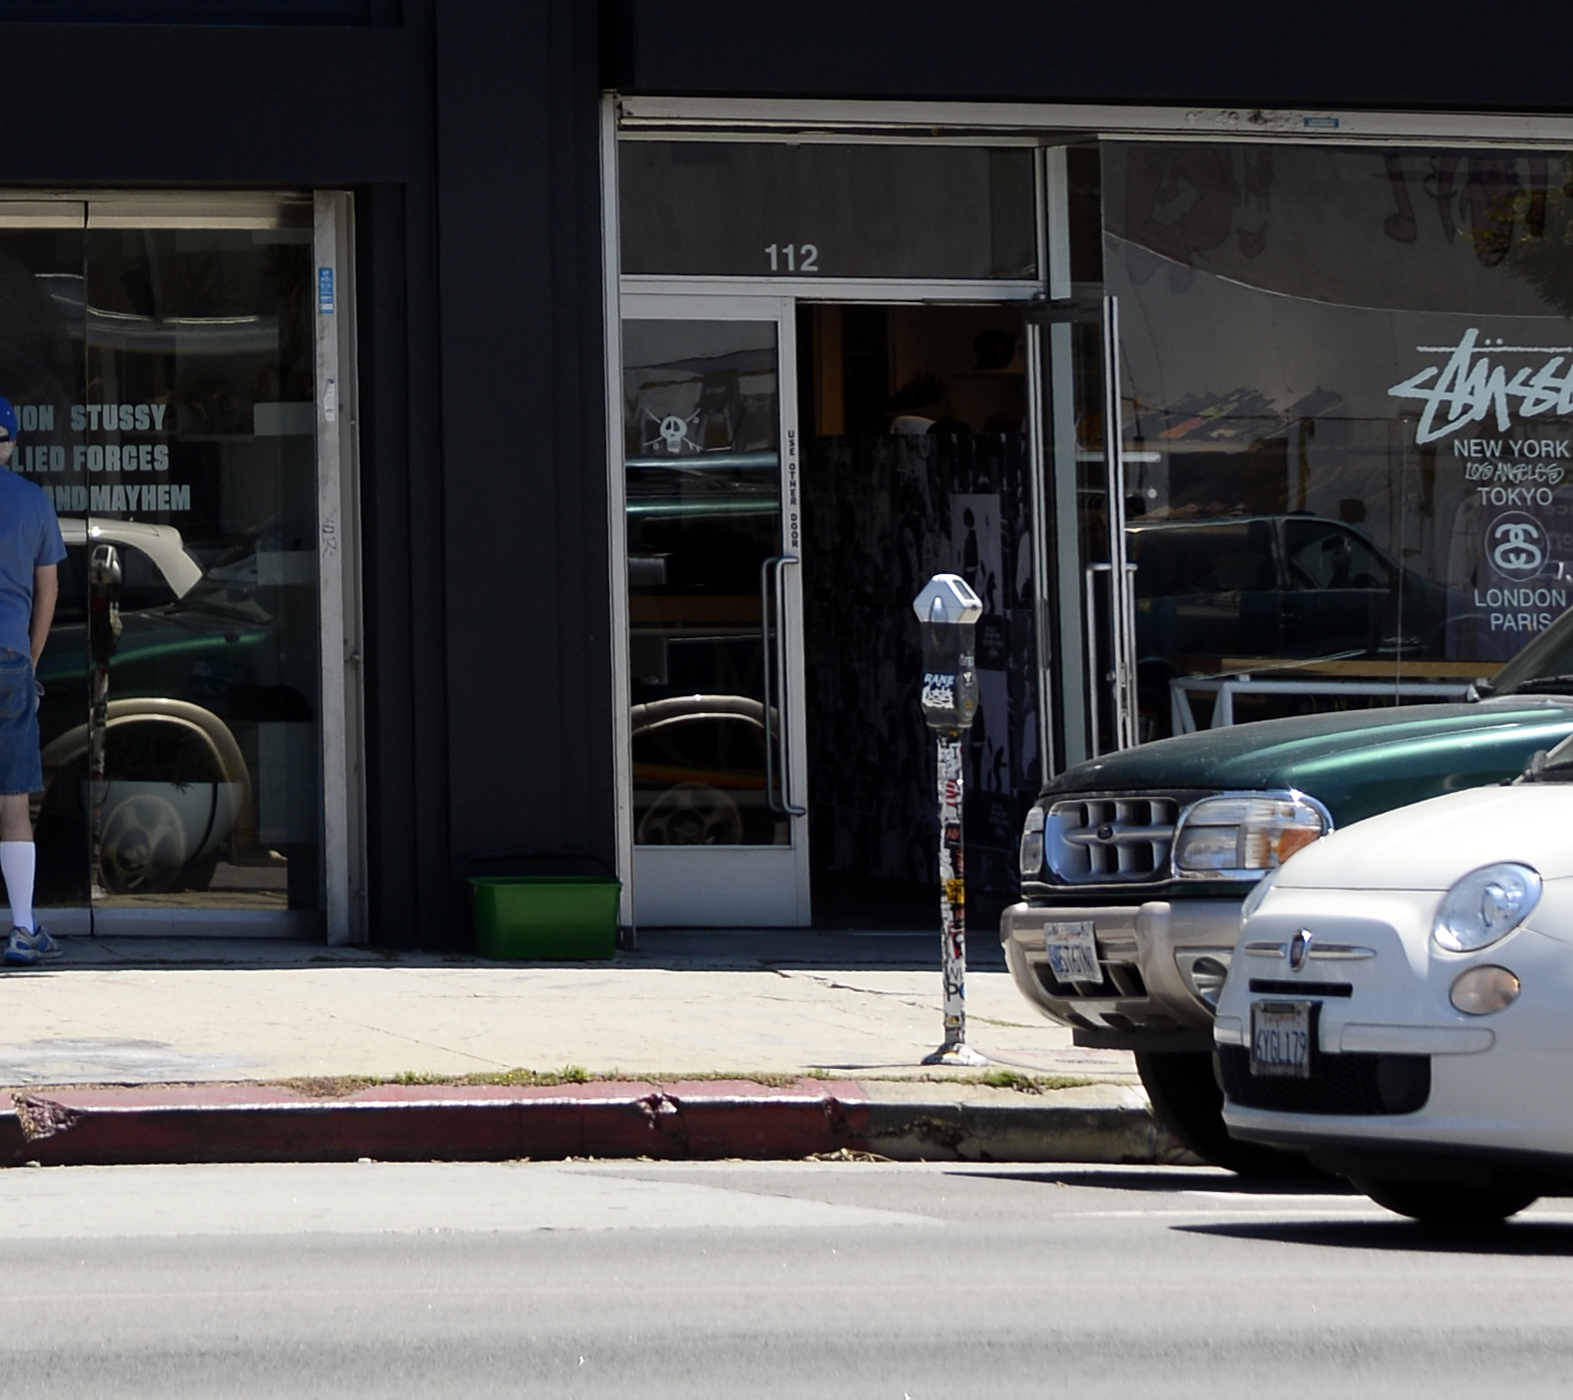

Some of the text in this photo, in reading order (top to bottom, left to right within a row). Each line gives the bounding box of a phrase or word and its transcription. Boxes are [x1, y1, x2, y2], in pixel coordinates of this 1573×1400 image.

[764, 243, 819, 271] 112
[13, 404, 166, 431] ION STUSSY
[2, 444, 169, 472] LIED FORCES
[1454, 439, 1570, 458] NEW YORK
[789, 462, 797, 505] OTHER
[1477, 487, 1553, 506] TOKYO
[90, 484, 191, 512] MAYHEM
[790, 513, 799, 548] DOOR
[1474, 588, 1566, 607] LONDON
[1490, 613, 1552, 631] PARIS
